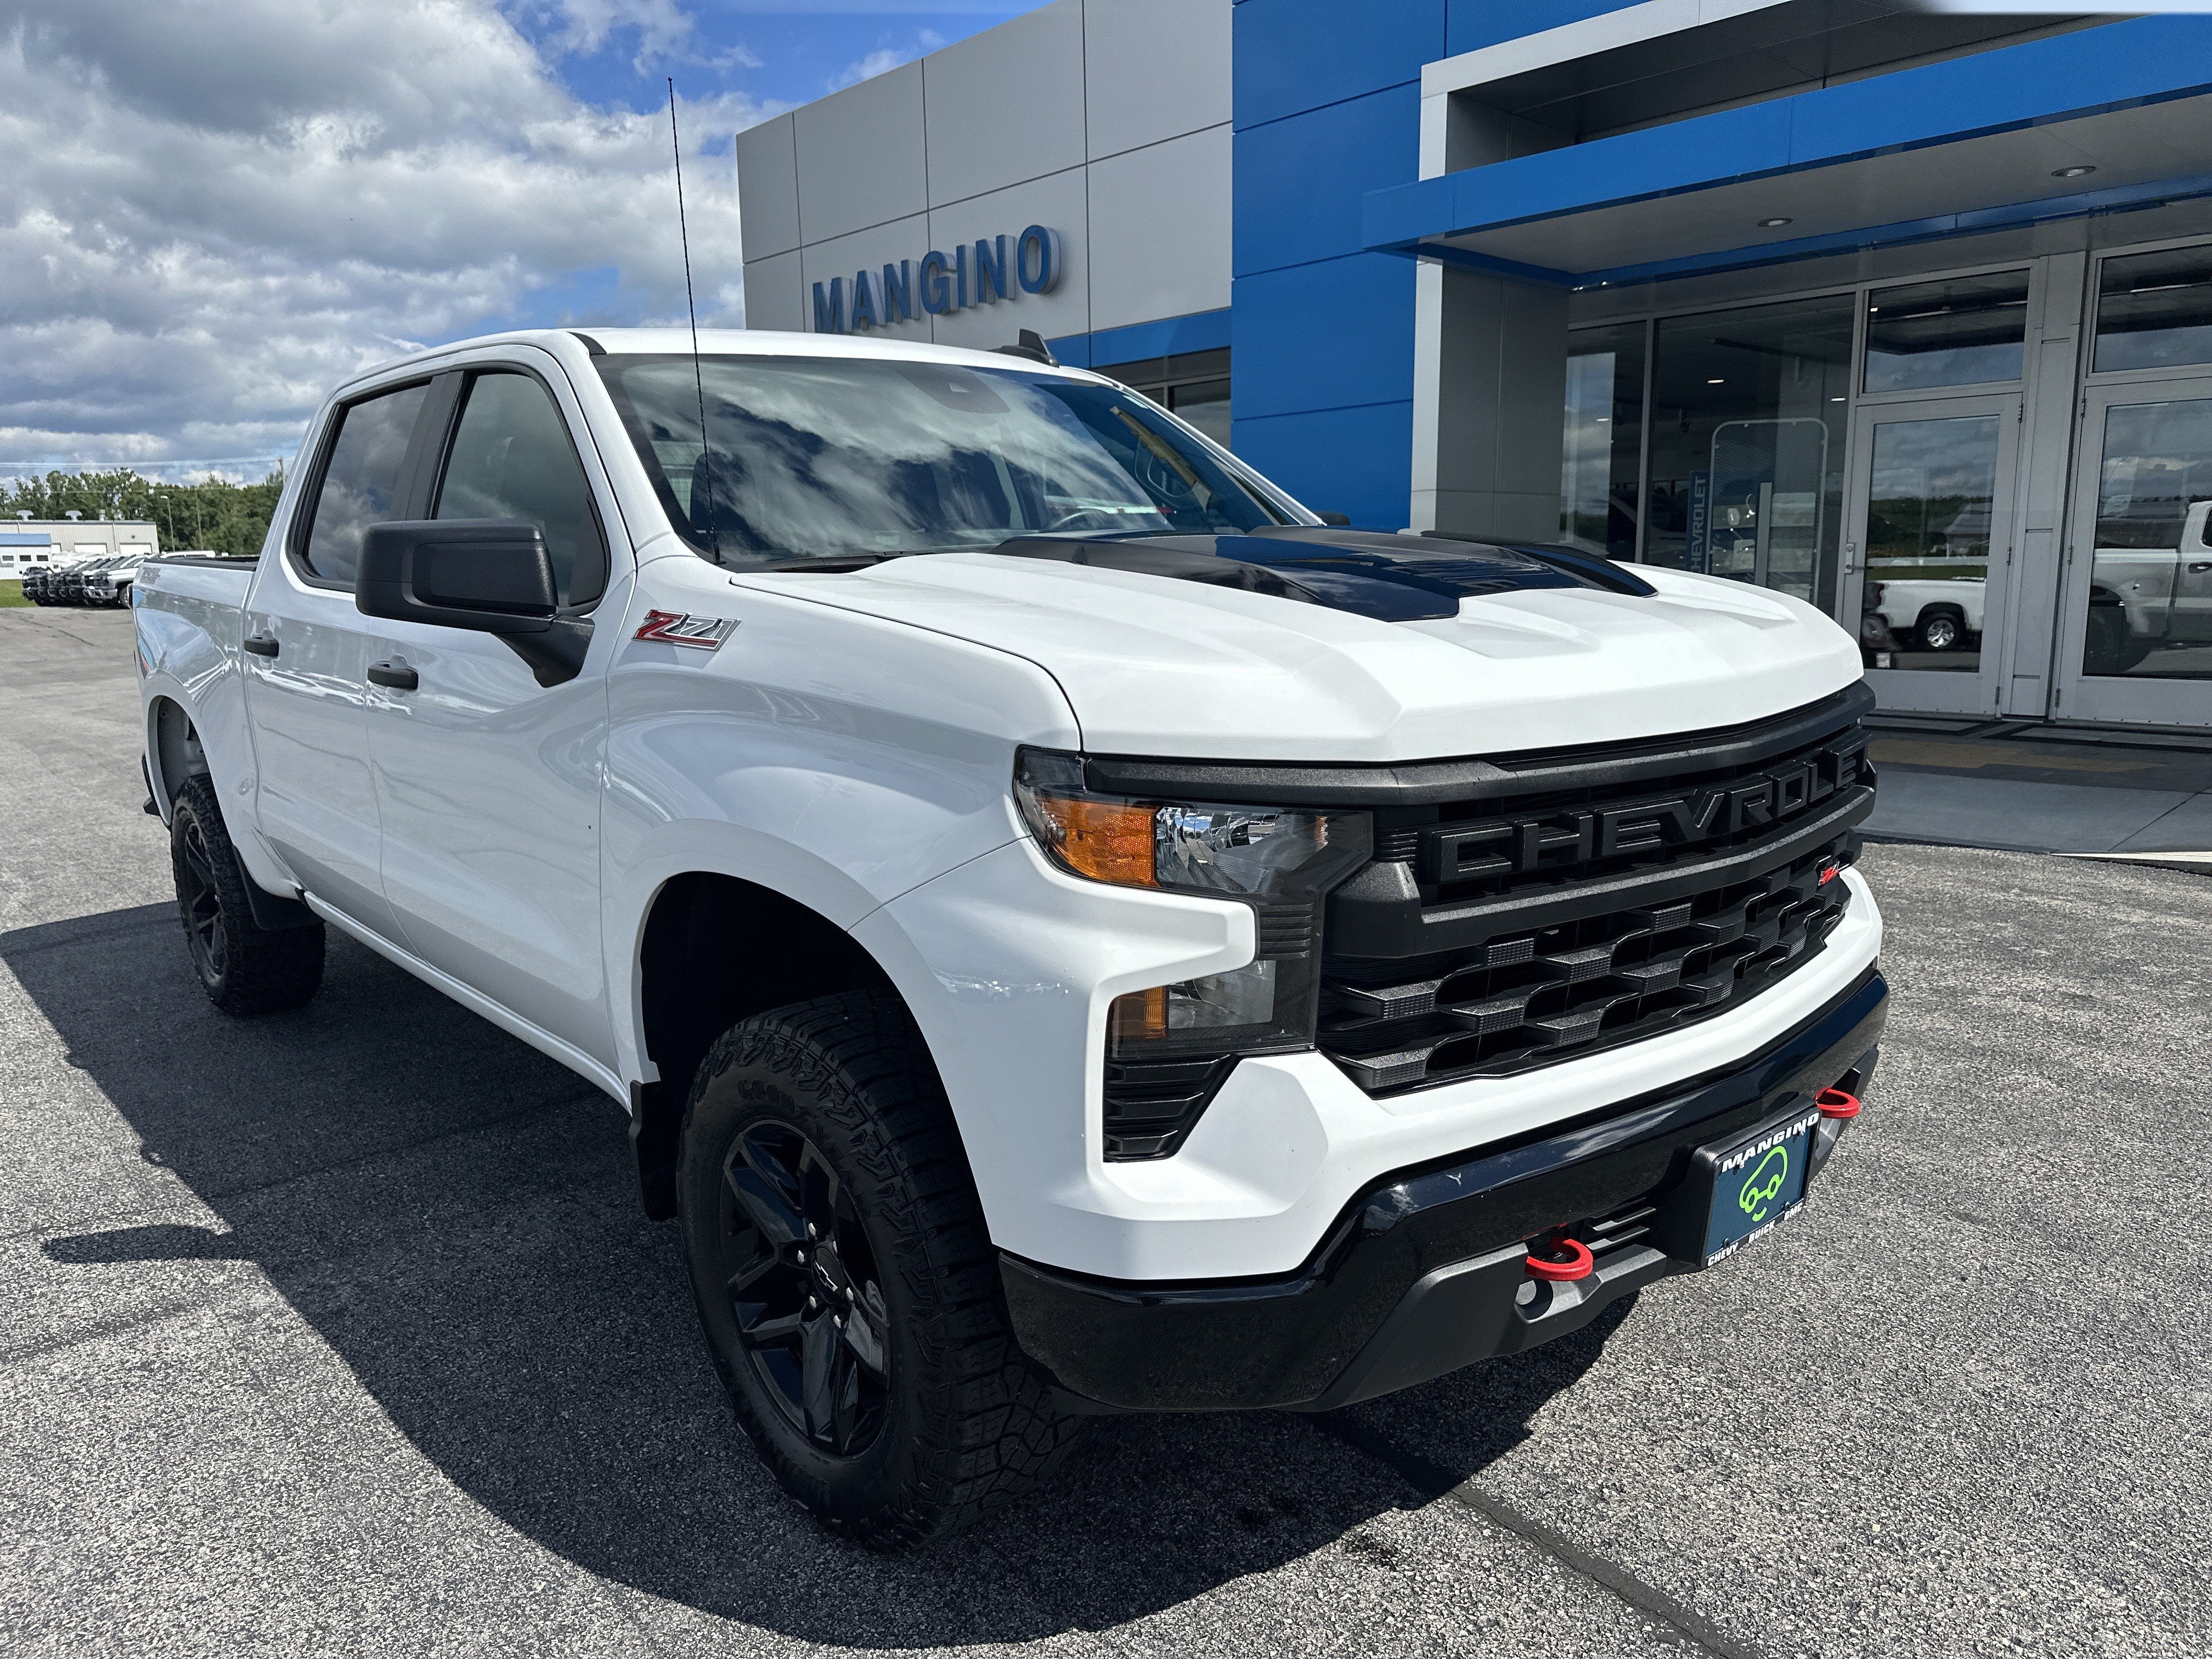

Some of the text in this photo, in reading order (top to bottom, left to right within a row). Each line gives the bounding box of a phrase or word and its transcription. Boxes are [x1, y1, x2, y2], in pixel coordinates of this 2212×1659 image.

[812, 224, 1058, 334] MANGINO
[1690, 476, 1706, 574] HEVROLET
[632, 609, 742, 652] Z71
[1722, 1112, 1819, 1172] MANGINO
[1707, 1203, 1803, 1266] CHEVY BUICK GMC
